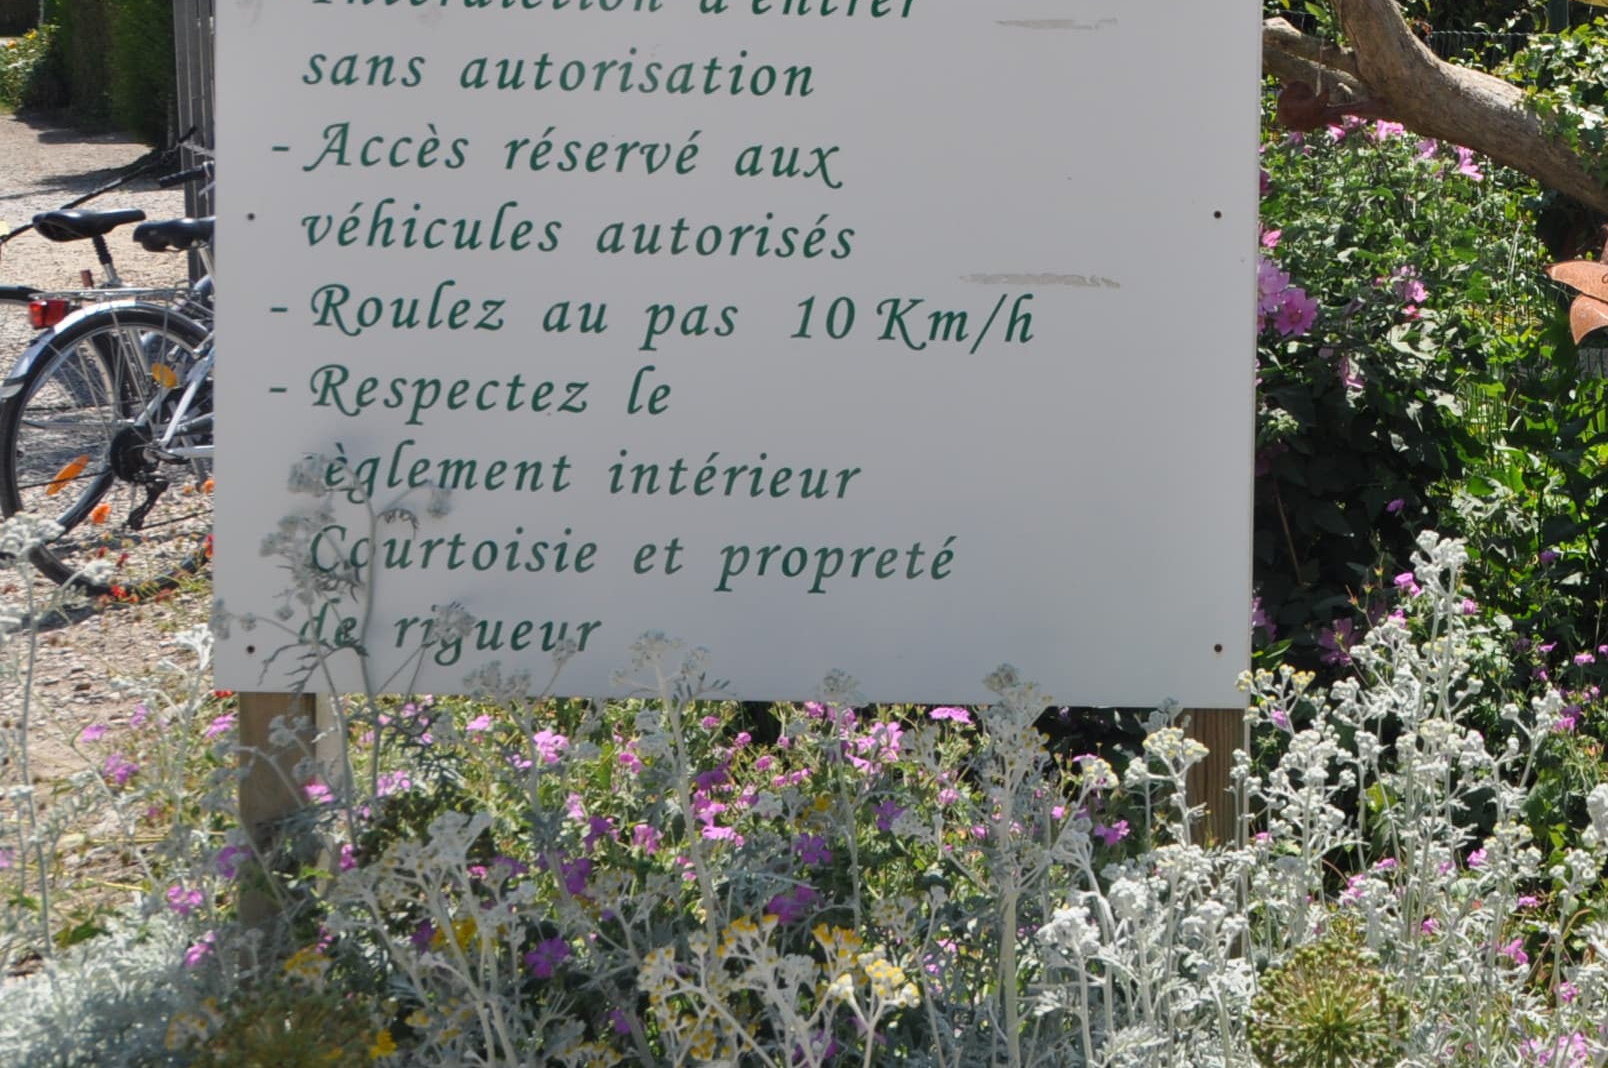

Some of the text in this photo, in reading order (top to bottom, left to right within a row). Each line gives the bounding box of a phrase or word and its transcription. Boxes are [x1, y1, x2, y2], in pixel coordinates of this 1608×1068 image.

[301, 46, 814, 99] sans autorisation
[302, 120, 471, 174] Accès
[504, 126, 703, 177] réservé
[733, 143, 845, 191] aux
[299, 196, 857, 261] véhicules autorisés
[309, 278, 508, 338] Roulez
[541, 299, 610, 336] au
[638, 302, 739, 353] pas
[791, 294, 857, 341] 10
[874, 291, 1036, 356] Km/h
[308, 362, 591, 427] Respectez
[625, 363, 673, 417] le
[300, 436, 864, 505] èglement intérieur
[309, 522, 959, 596] Courtoisie et propreté
[298, 596, 603, 667] de rigueur
